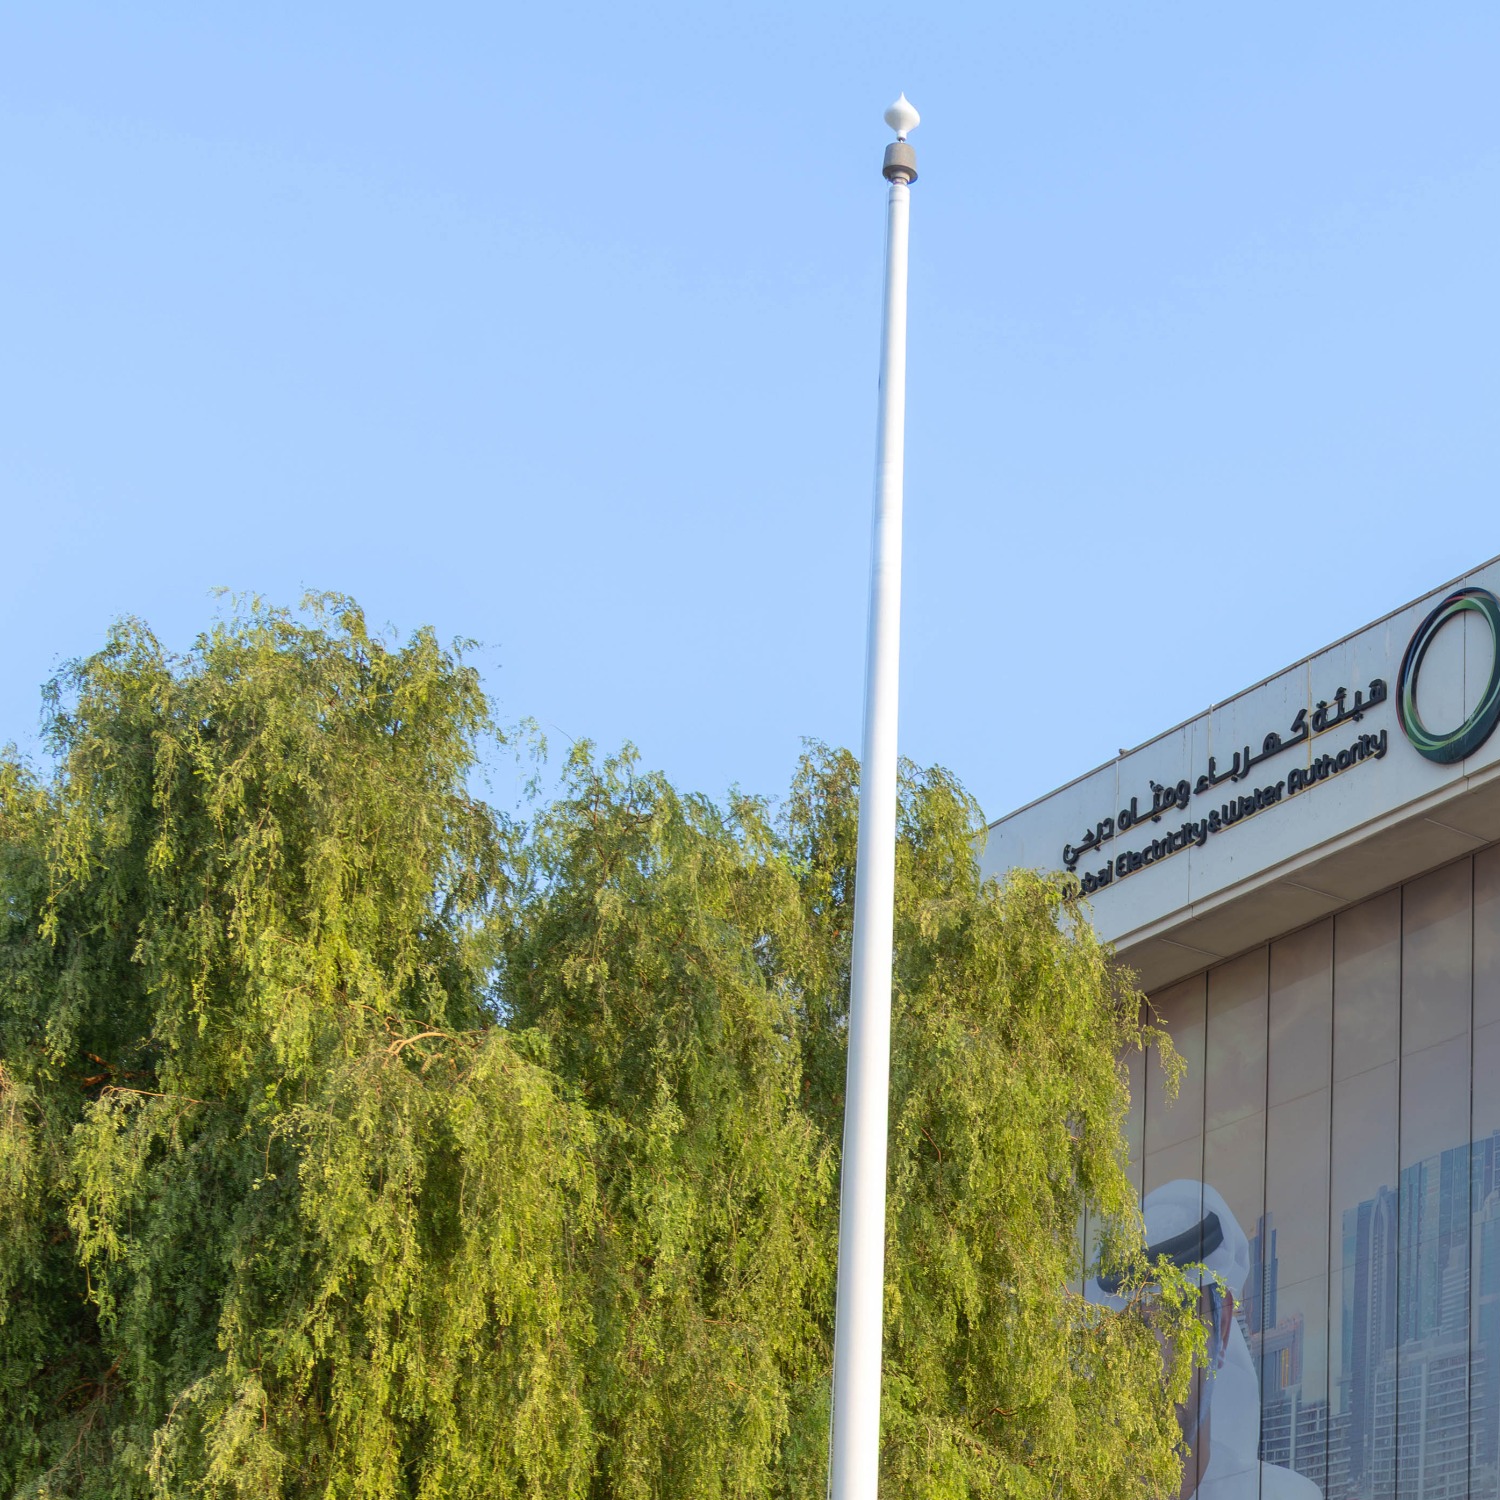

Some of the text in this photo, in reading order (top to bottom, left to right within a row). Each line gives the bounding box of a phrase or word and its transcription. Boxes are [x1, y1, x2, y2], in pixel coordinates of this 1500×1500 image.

[1063, 679, 1387, 872] هيئة كهرباء ومياه دبي
[1115, 819, 1207, 878] Electricity
[1221, 781, 1286, 825] Water
[1288, 729, 1387, 795] Authority
